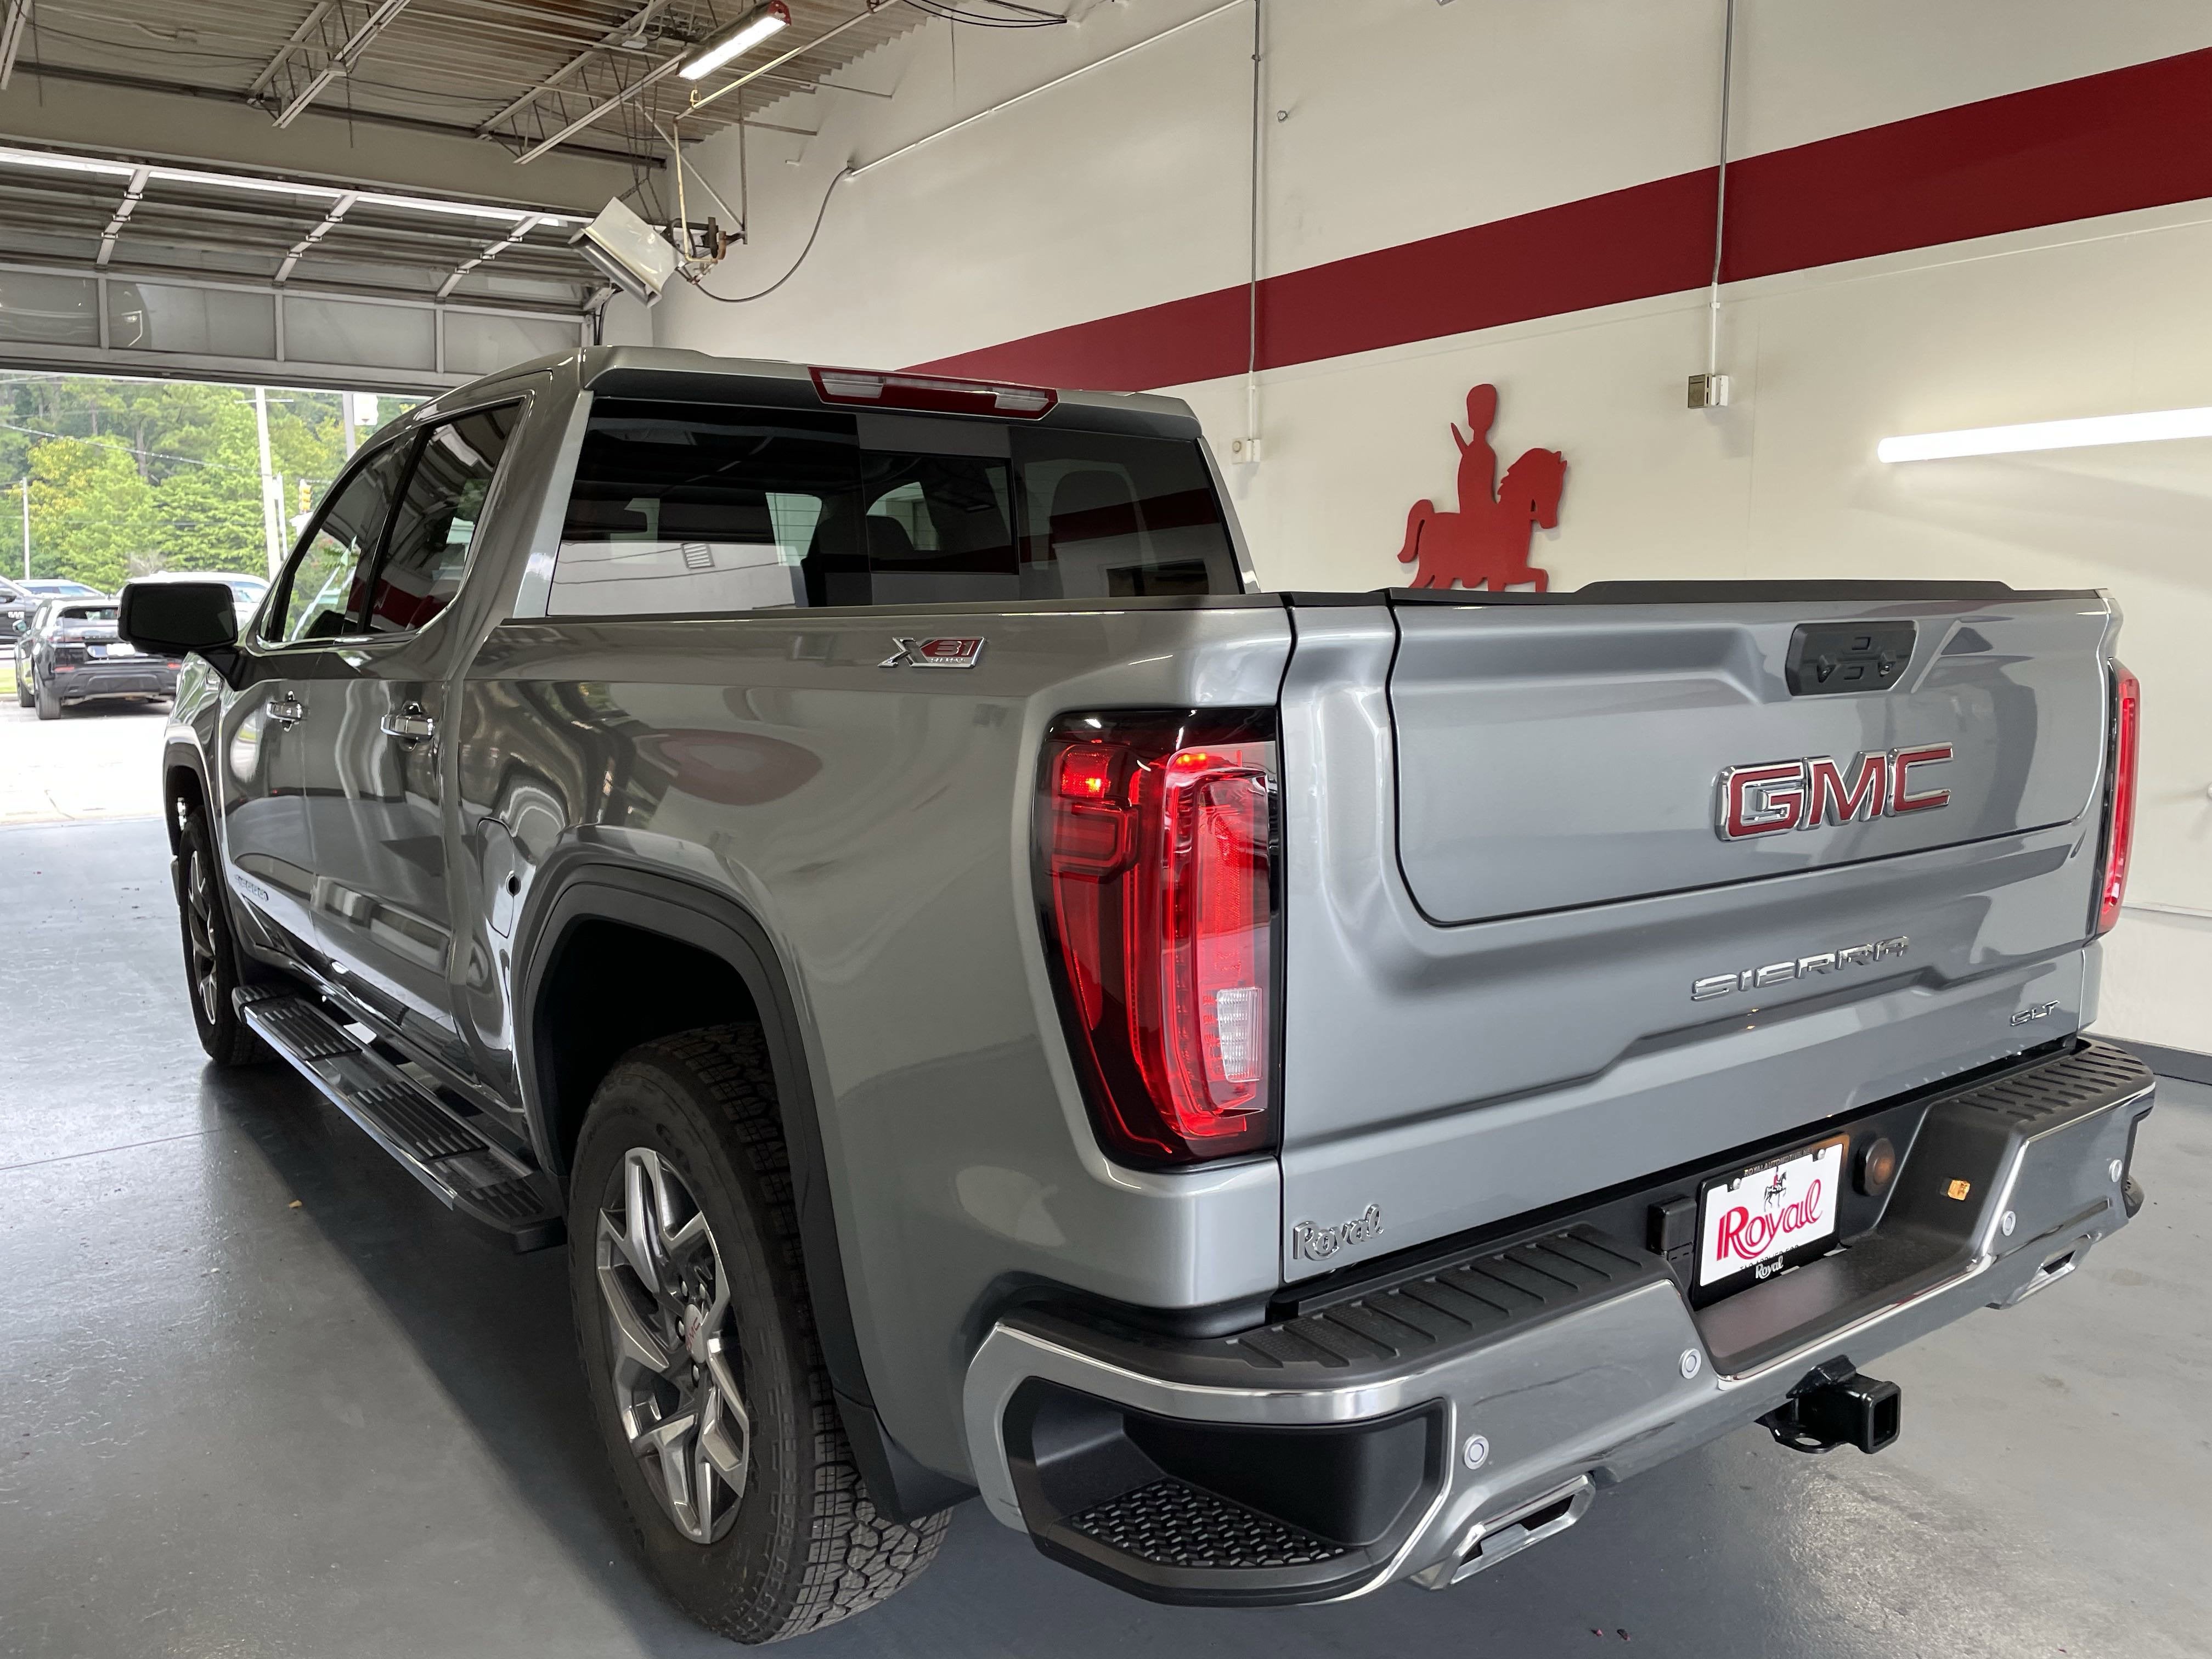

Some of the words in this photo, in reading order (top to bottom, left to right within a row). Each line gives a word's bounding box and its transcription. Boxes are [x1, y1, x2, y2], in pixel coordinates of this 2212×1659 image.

[877, 636, 986, 668] X31
[1714, 742, 1954, 843] GMC
[1691, 935, 1910, 1002] SIERRA
[2010, 1000, 2060, 1026] SLT
[1293, 1203, 1385, 1261] Royal
[1716, 1179, 1824, 1261] Royal
[1755, 1255, 1784, 1279] Royal
